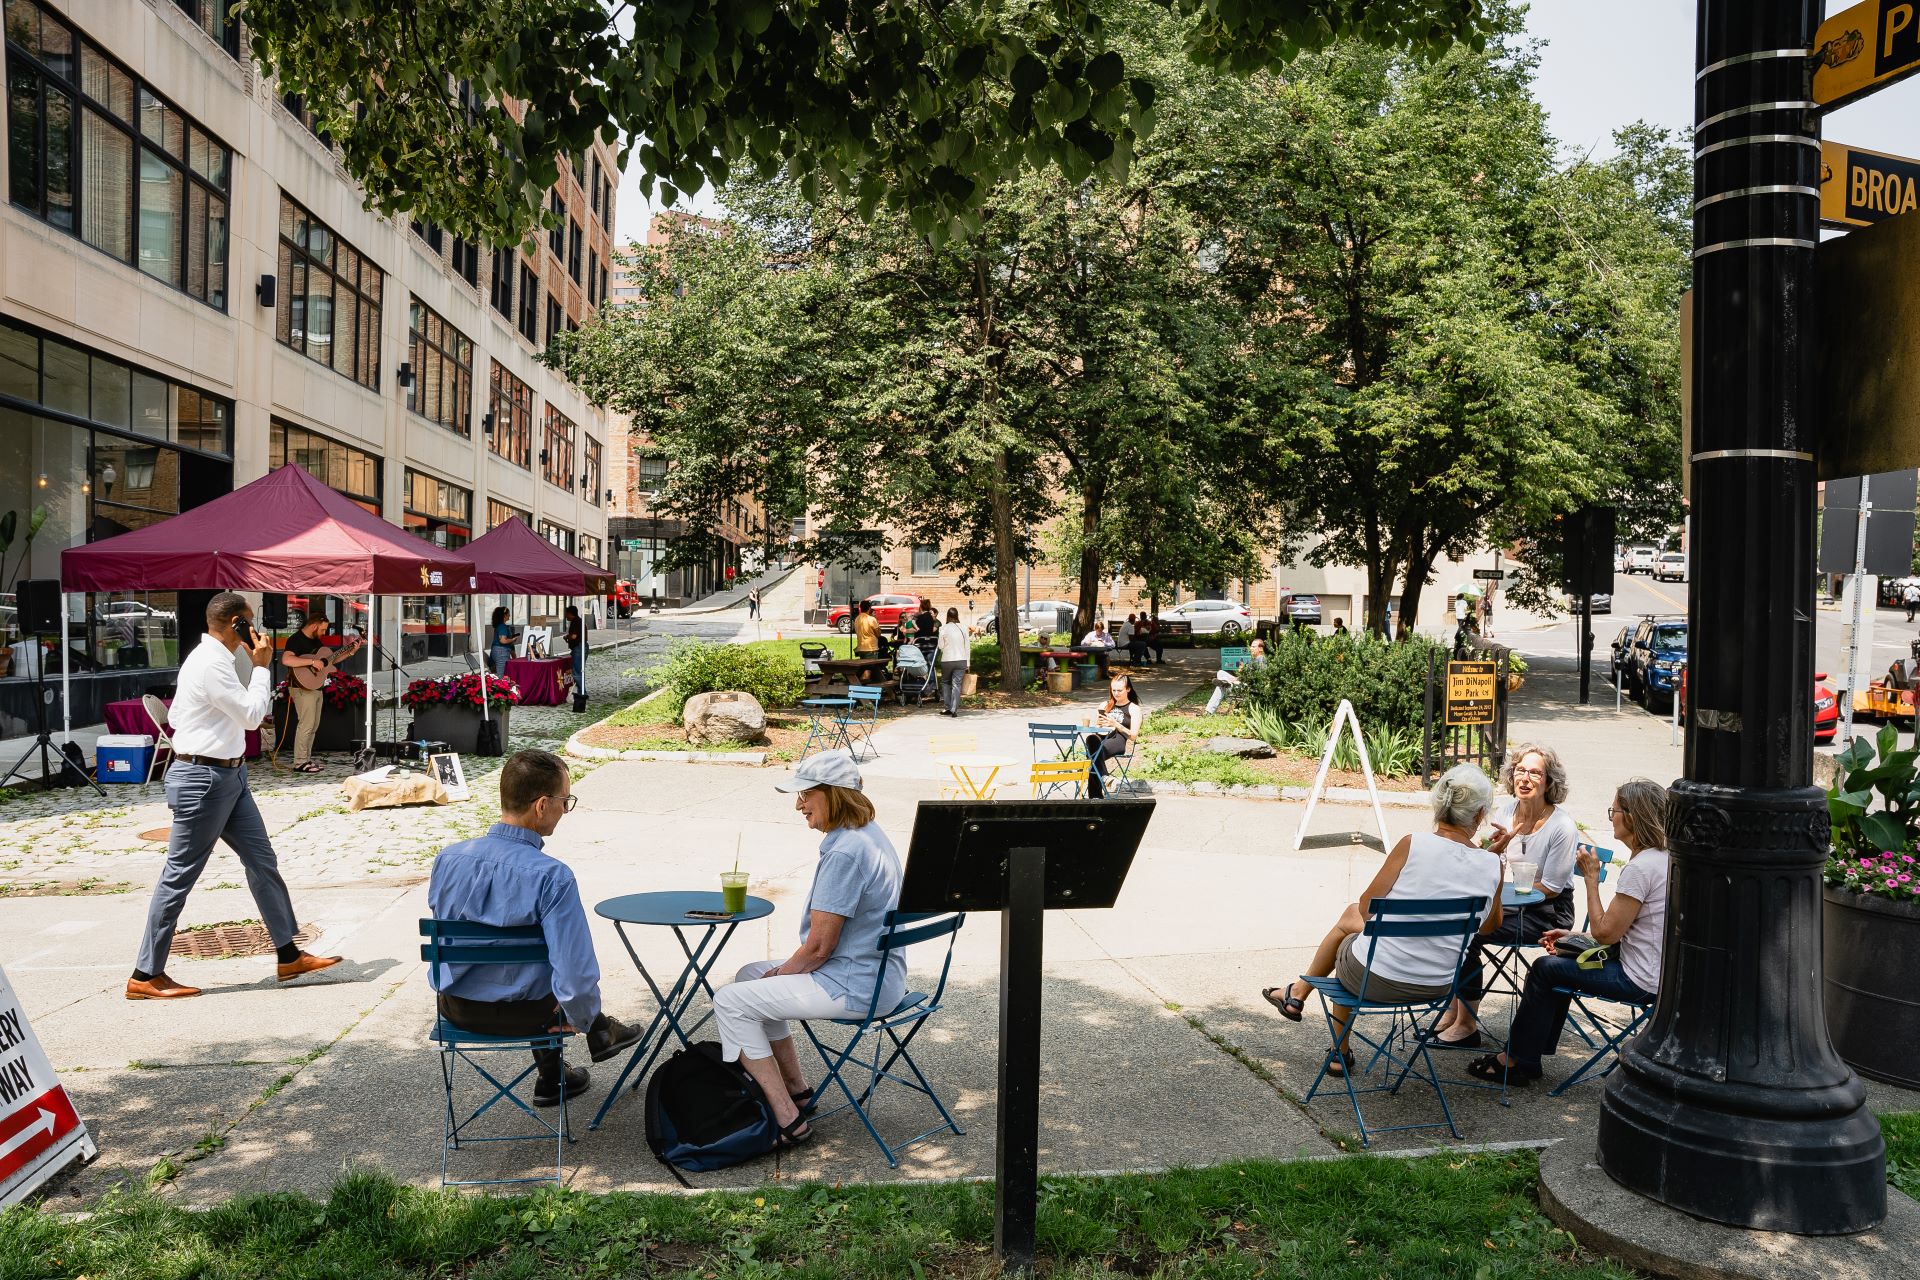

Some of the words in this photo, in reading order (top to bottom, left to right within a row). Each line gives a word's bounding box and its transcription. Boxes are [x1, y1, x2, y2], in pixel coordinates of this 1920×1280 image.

[1883, 3, 1920, 57] P
[1453, 677, 1463, 687] Jim
[1466, 677, 1491, 687] DiNapoli
[1466, 689, 1479, 697] Park
